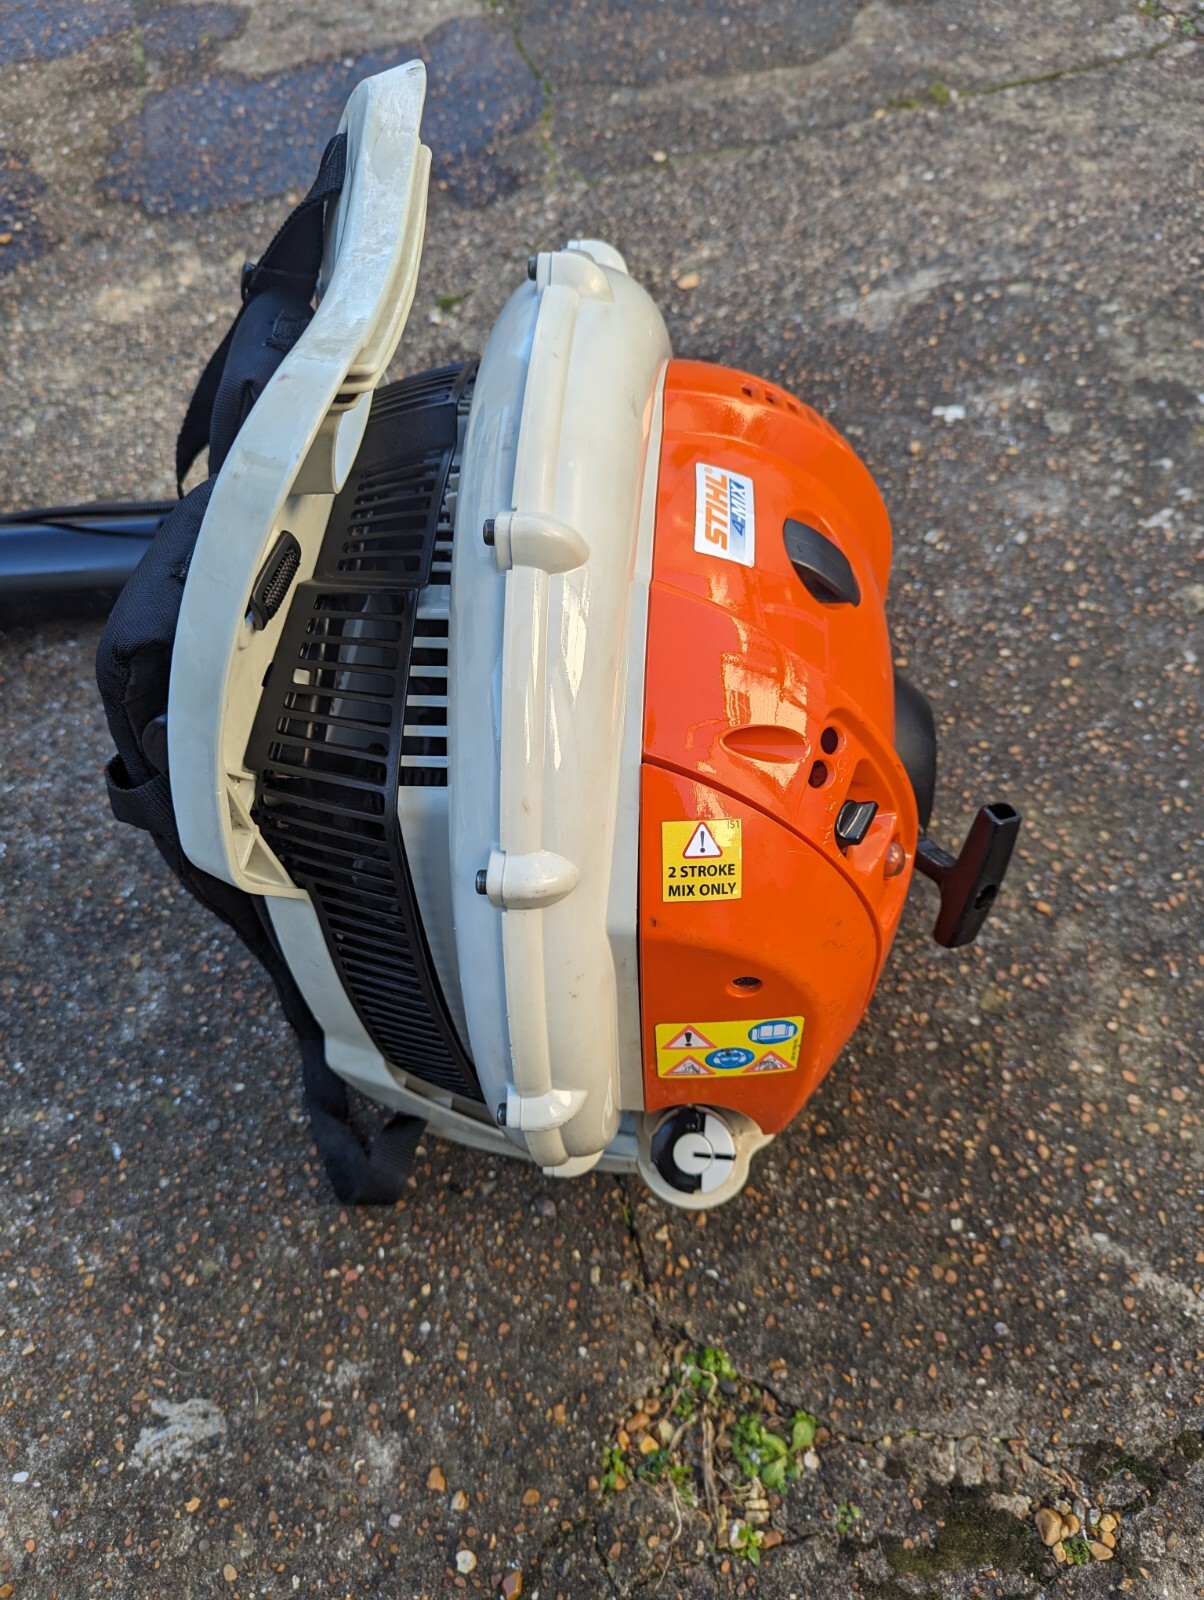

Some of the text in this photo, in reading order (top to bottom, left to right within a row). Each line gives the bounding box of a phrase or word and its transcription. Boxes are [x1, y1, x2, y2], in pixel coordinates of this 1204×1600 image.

[705, 474, 728, 551] STIHL
[729, 478, 746, 537] 4-MIX
[668, 863, 735, 878] 2 STROKE
[668, 882, 737, 897] MIX ONLY
